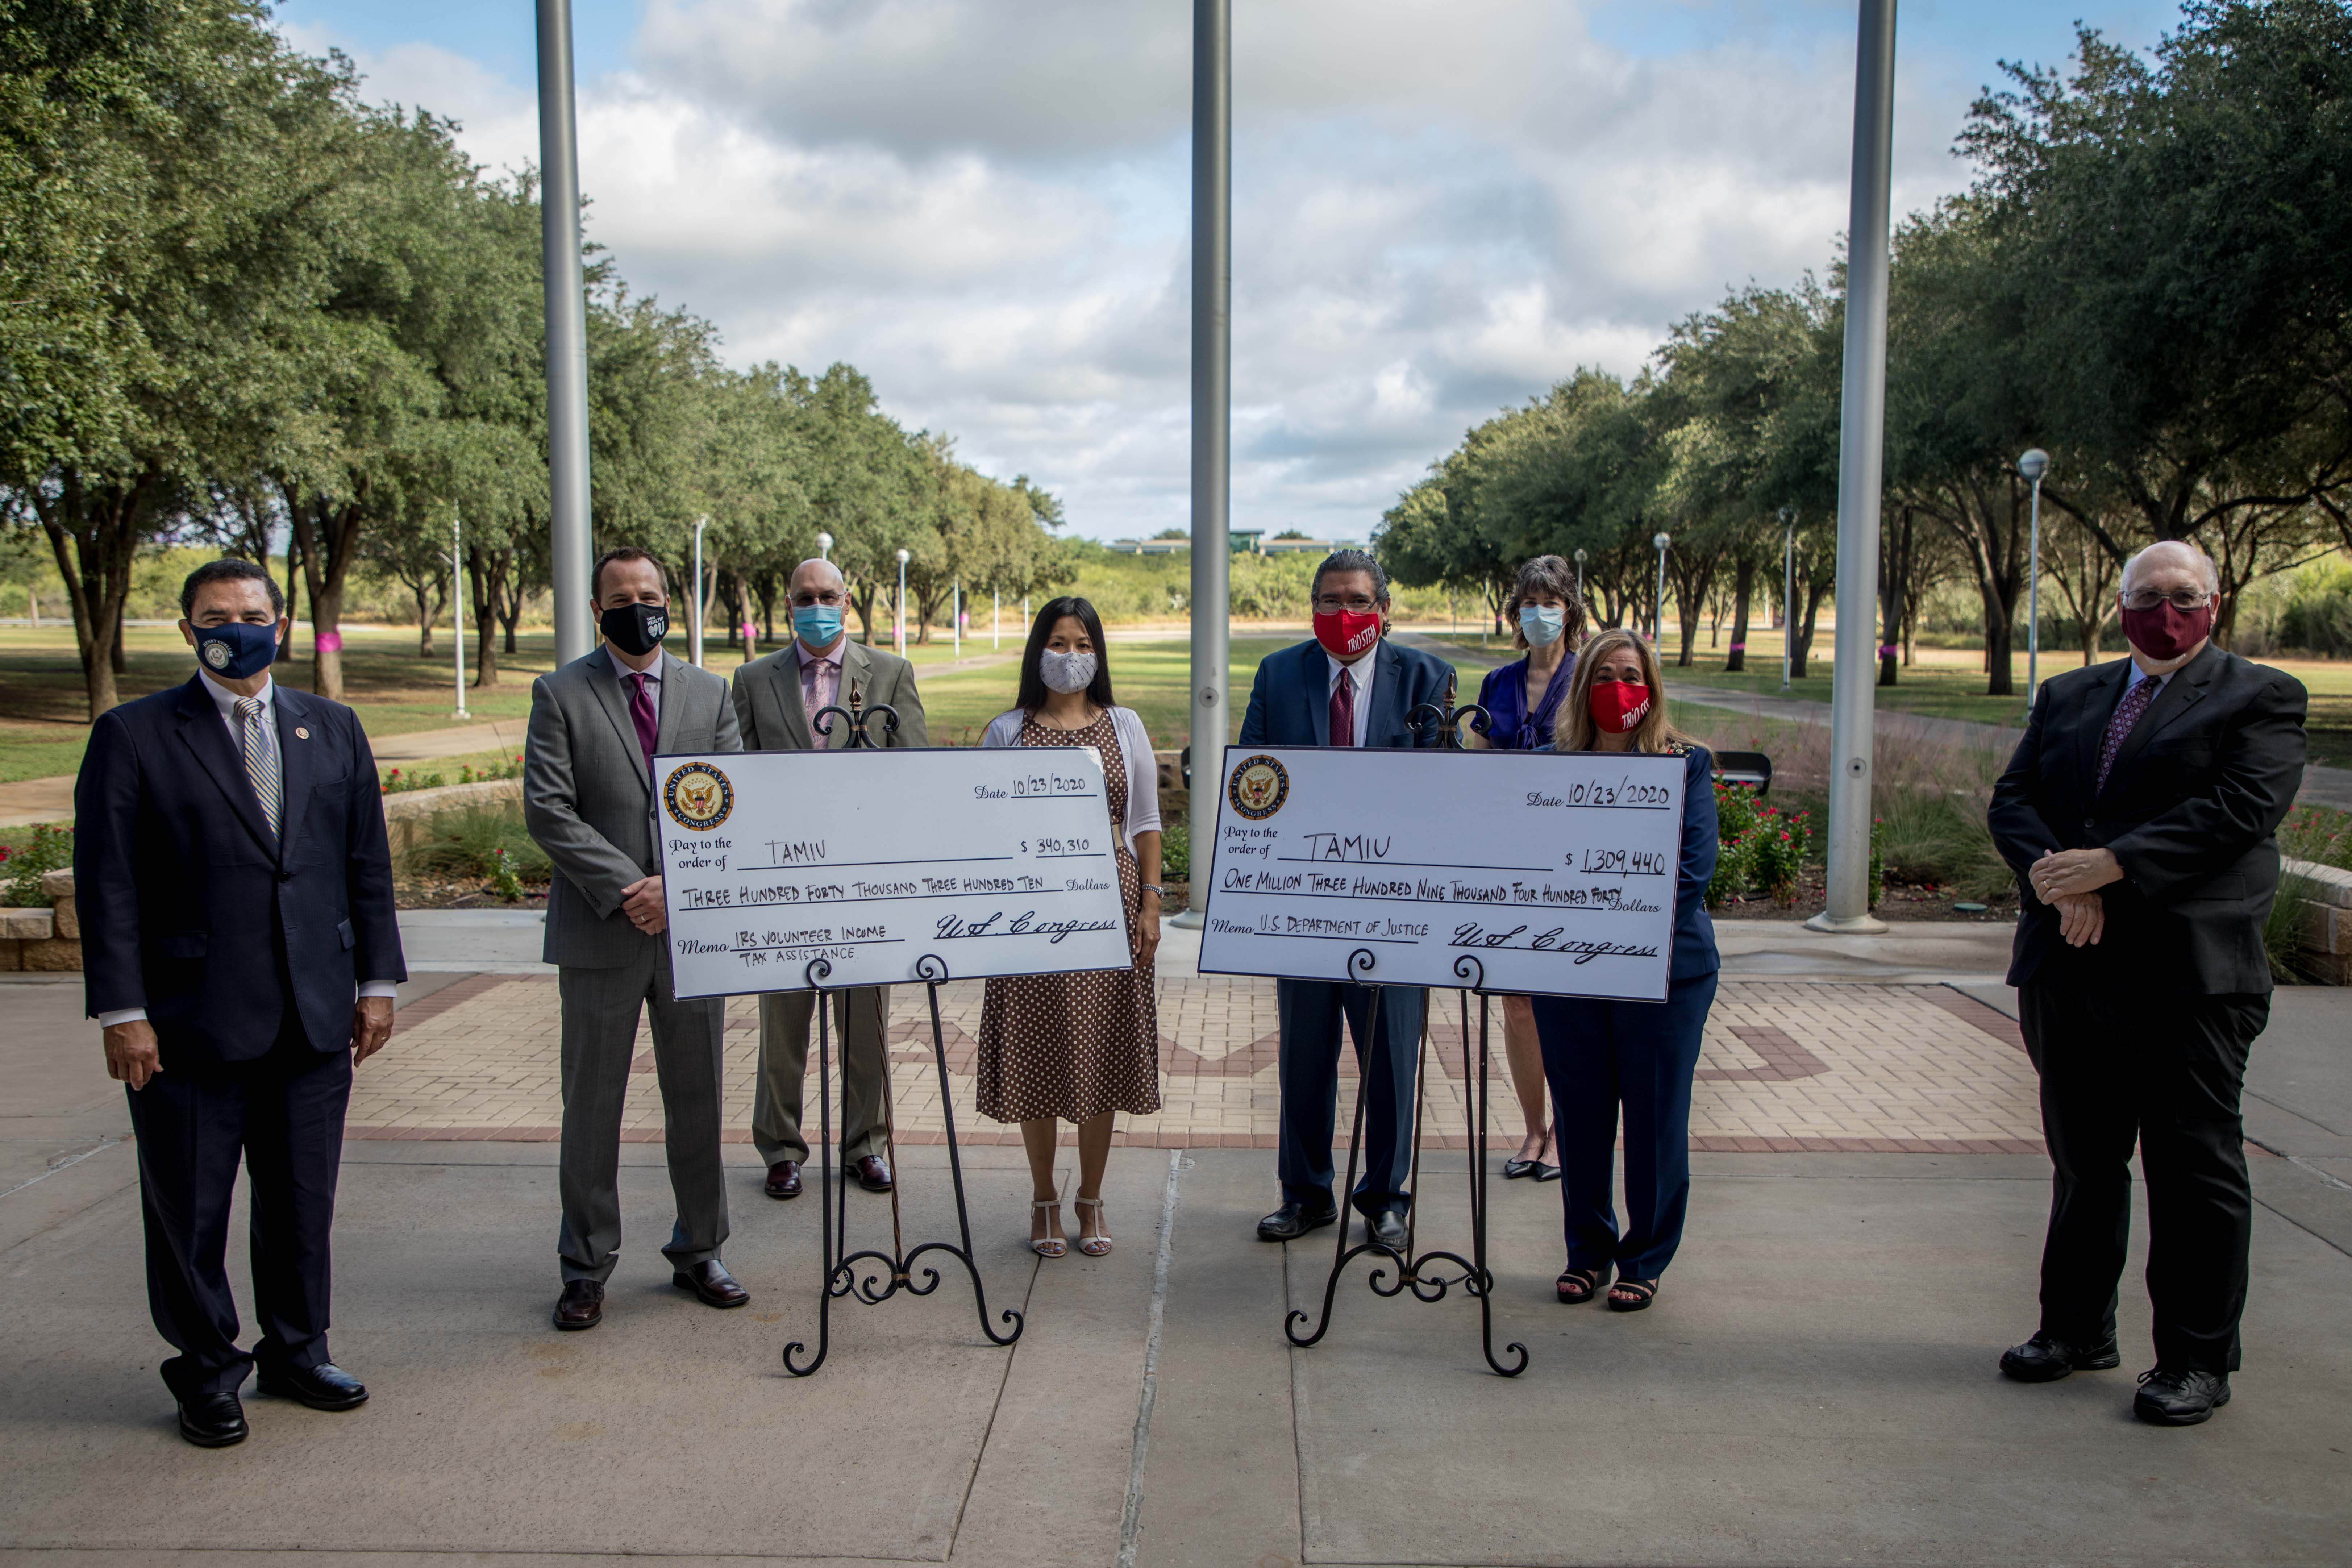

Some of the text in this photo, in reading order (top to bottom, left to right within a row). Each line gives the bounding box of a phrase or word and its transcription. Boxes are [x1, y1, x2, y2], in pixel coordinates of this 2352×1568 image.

[658, 620, 665, 635] U
[1361, 623, 1377, 647] STEM
[203, 639, 217, 648] HENRY
[217, 640, 233, 657] CUELLAR
[669, 766, 729, 797] UNITED STATES
[1233, 759, 1285, 787] UNITED STATES
[974, 785, 1008, 799] Date
[1013, 773, 1085, 795] 10/23/2020
[1568, 775, 1669, 807] 10/23/2020
[1527, 791, 1564, 806] Date
[1237, 802, 1277, 816] CONGRESS
[678, 812, 724, 827] CONGRESS
[1224, 826, 1278, 841] Pay to the
[669, 837, 732, 856] Pay to the
[765, 839, 825, 865] TAMIU
[1021, 841, 1028, 853] $
[1036, 837, 1089, 857] 340,310
[1228, 844, 1271, 859] order of
[1304, 833, 1390, 863] TAMIU
[679, 855, 728, 872] order of
[1565, 853, 1572, 866] $
[1585, 849, 1665, 878] 1,309,440
[682, 875, 1043, 908] THREE HUNDRED FORTY THOUSAND THREE HUNDRED TEN
[1066, 878, 1110, 891] Dollars
[1224, 868, 1622, 904] ONE MILLION THREE HUNDRED NINE THOUSAND FOUR HUNDRED FORTY
[1608, 898, 1661, 912] Dollars
[1010, 911, 1117, 944] Congress
[1212, 919, 1254, 933] Memo
[1261, 914, 1429, 936] U.S. DEPARTMENT OF JUSTICE
[736, 926, 886, 948] IRS VOLUNTEER INCOME
[1531, 928, 1658, 965] Congress
[678, 940, 729, 954] Memo
[739, 947, 854, 968] TAX ASSISTANCE
